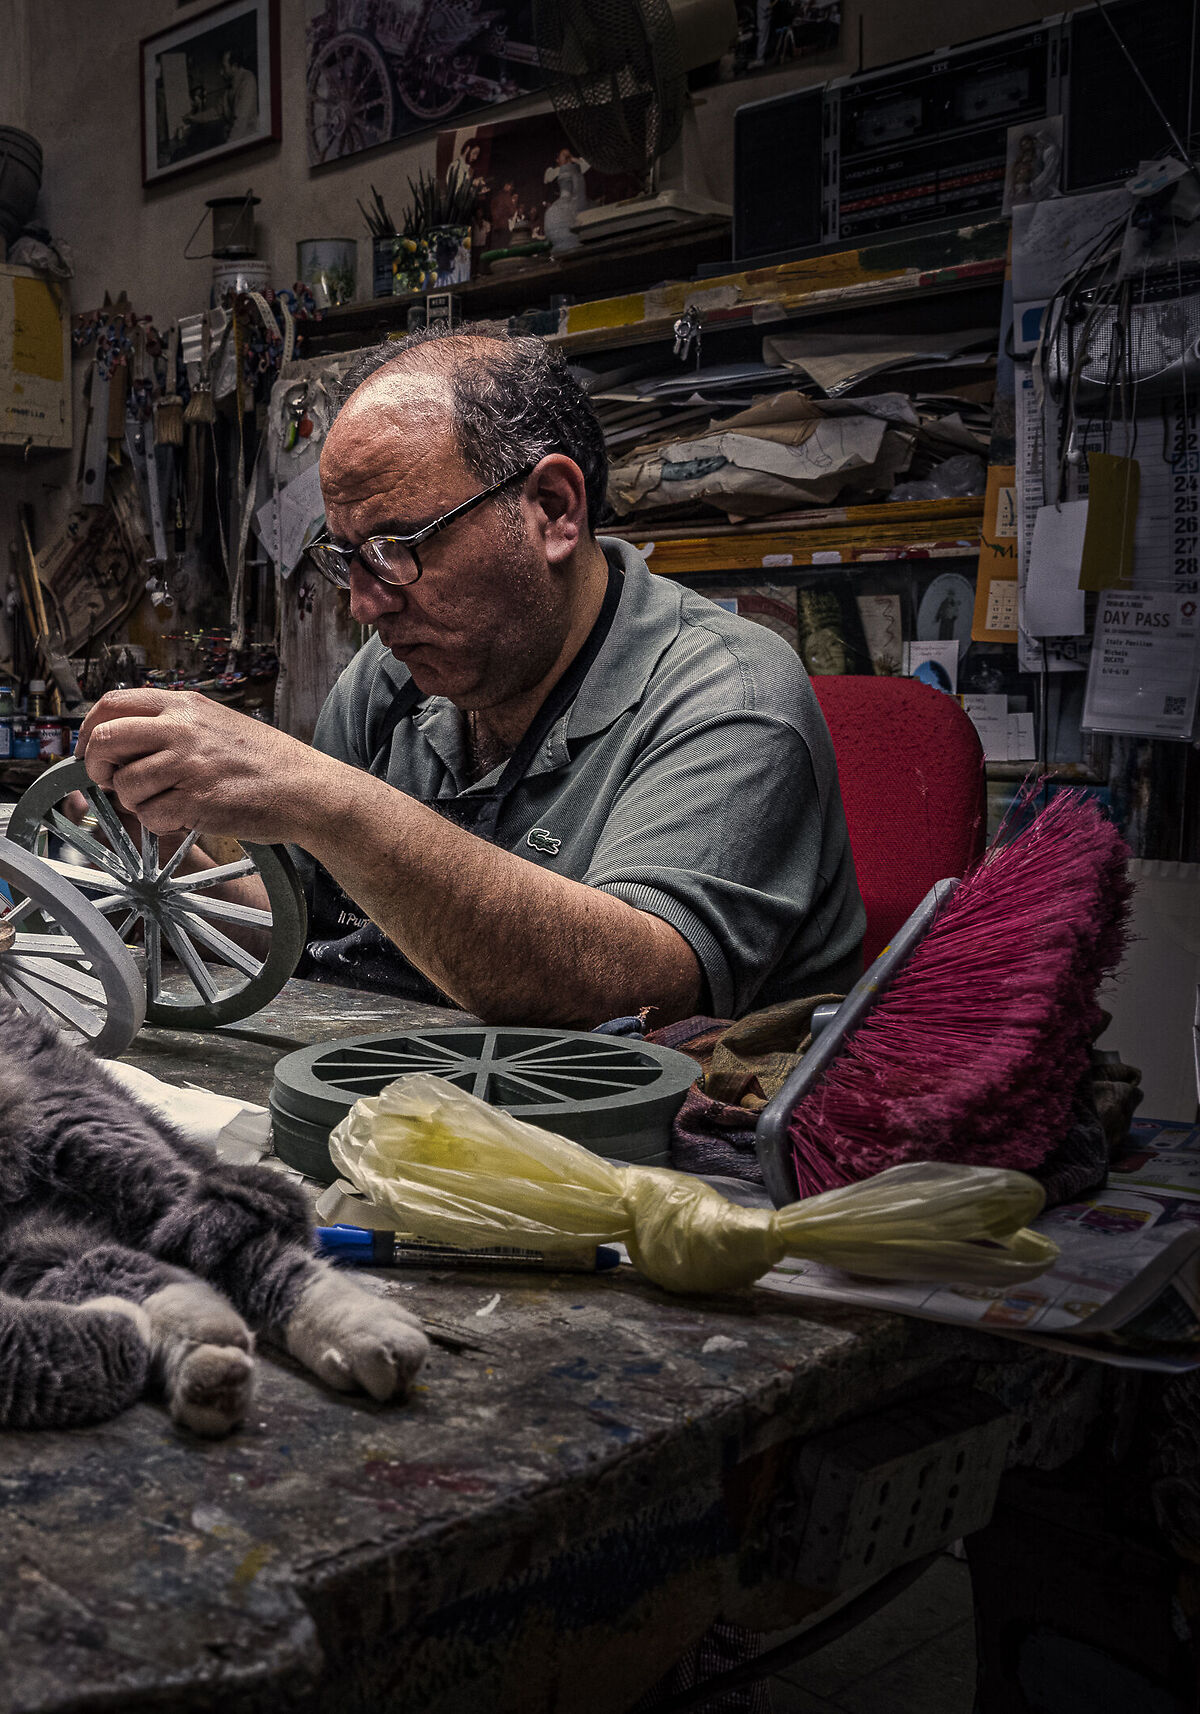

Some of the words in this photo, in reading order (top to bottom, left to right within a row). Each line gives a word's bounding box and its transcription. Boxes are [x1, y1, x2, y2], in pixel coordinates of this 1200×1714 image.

[1174, 475, 1198, 493] 24
[1174, 495, 1198, 514] 25
[1174, 516, 1198, 535] 26
[1174, 537, 1198, 555] 27
[1174, 557, 1198, 576] 28
[1103, 610, 1130, 626] DAY
[1135, 612, 1170, 628] PASS
